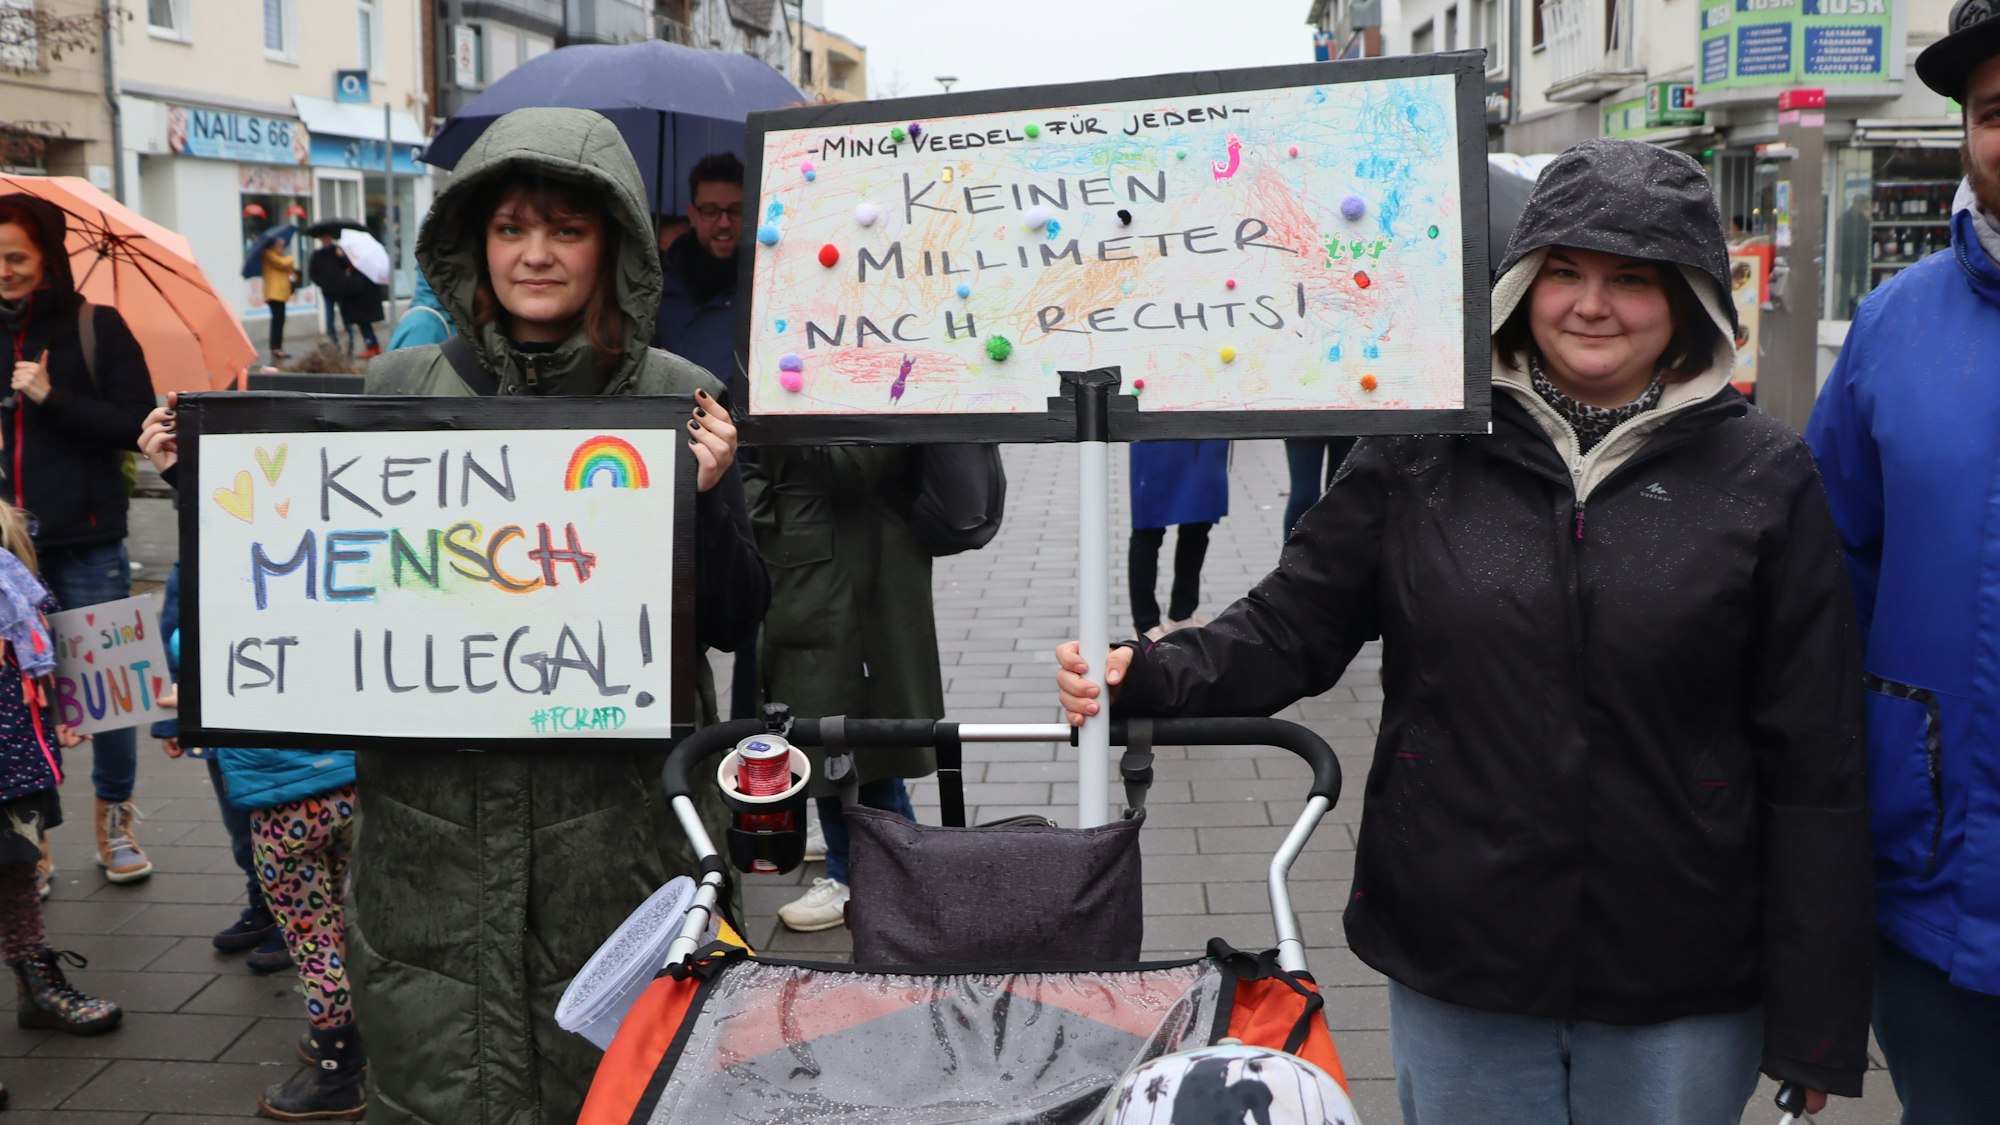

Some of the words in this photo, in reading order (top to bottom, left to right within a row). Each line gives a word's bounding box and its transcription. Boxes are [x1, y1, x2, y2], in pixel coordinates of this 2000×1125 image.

[193, 109, 261, 144] NAILS
[268, 120, 290, 147] 66
[909, 128, 1025, 153] VEEDEL
[1045, 116, 1107, 136] FÜR
[902, 170, 1166, 224] KEINEN
[857, 217, 1298, 283] MILLIMETER
[805, 309, 979, 350] NACH
[1037, 281, 1307, 337] RECHTS!
[320, 444, 516, 521] KEIN
[250, 521, 597, 610] MENSCH
[51, 627, 84, 658] ir
[100, 609, 145, 650] sind
[226, 635, 299, 697] IST
[354, 603, 656, 708] ILLEGAL!
[55, 660, 151, 728] BUNT
